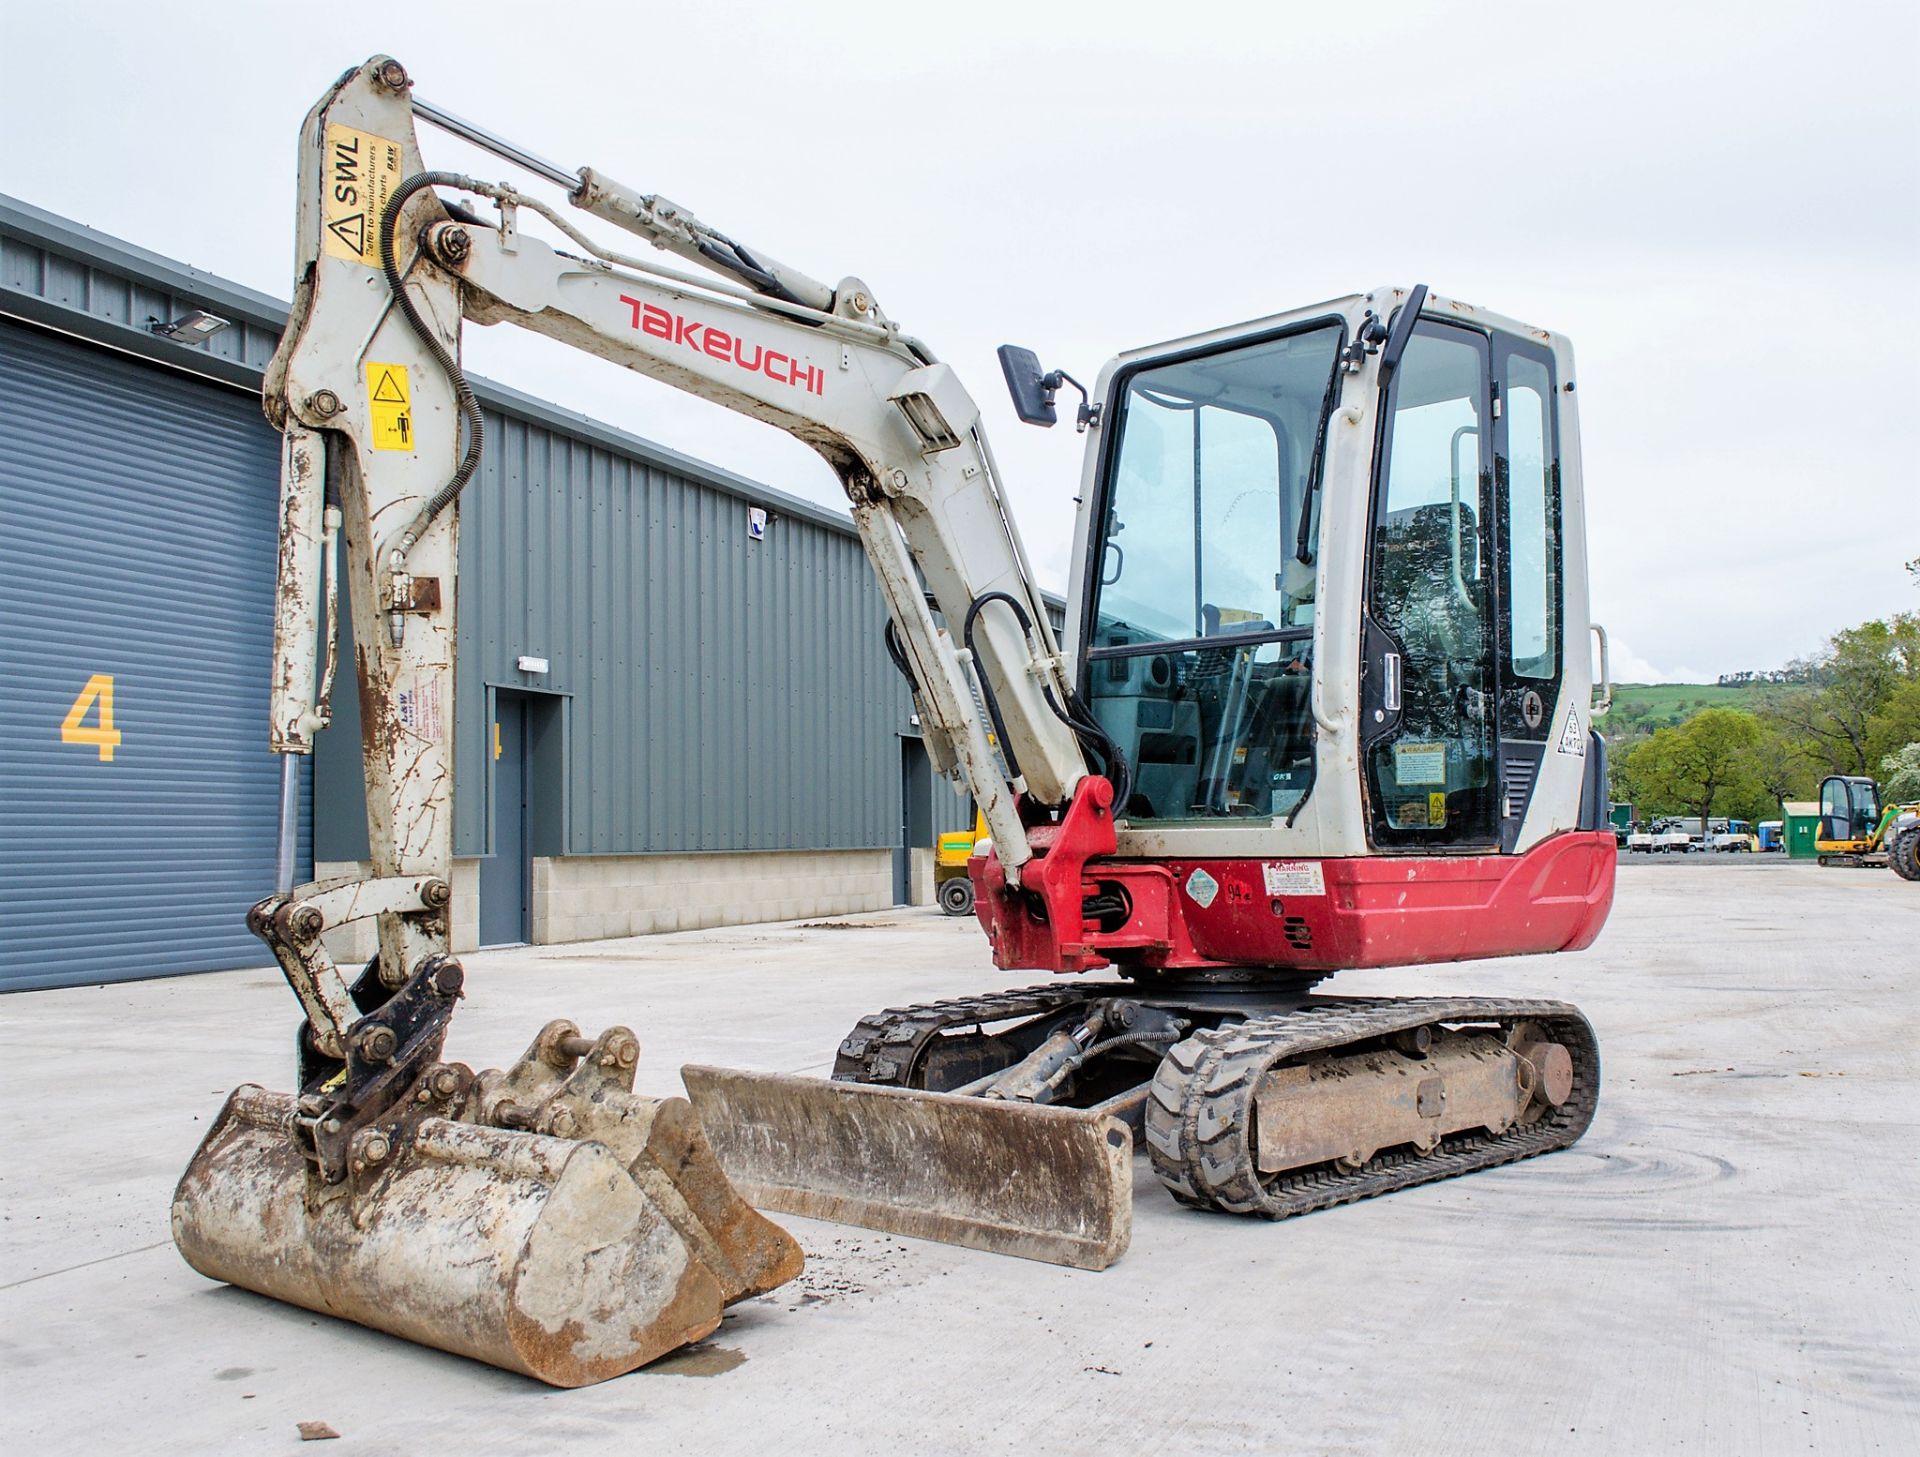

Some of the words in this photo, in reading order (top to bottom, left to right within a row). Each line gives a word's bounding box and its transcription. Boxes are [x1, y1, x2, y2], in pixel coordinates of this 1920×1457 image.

[335, 137, 358, 206] SWL
[379, 174, 387, 205] charts
[368, 218, 375, 229] to
[61, 674, 122, 762] 4
